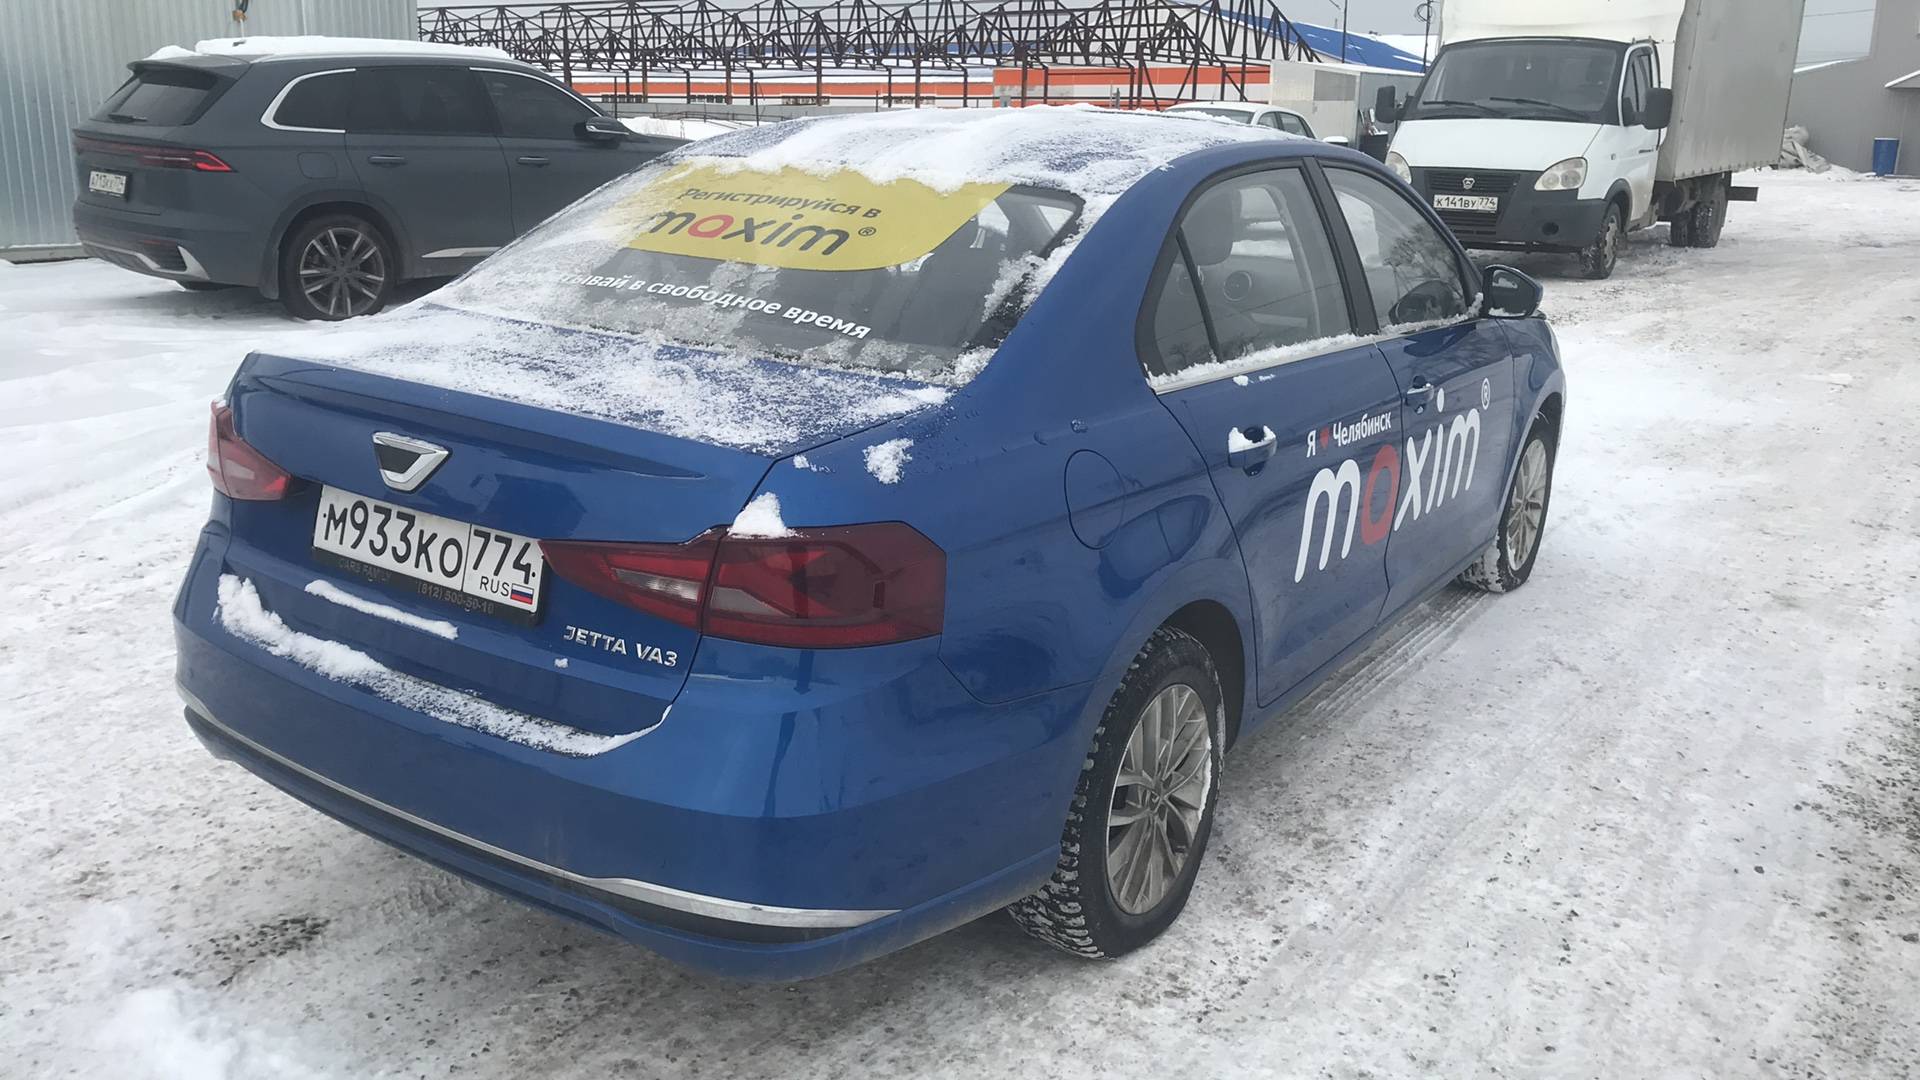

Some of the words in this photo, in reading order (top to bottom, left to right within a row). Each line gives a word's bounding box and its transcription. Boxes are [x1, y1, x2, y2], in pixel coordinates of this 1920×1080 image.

[677, 187, 861, 216] Регистрируйся
[862, 207, 881, 219] в
[1436, 196, 1476, 208] К141ВУ
[628, 279, 647, 291] в
[647, 281, 782, 315] свободное
[783, 306, 872, 340] время
[1306, 429, 1317, 458] Я
[1332, 411, 1392, 447] Челябинск
[323, 500, 463, 578] М933КО
[473, 529, 533, 585] 774
[480, 575, 510, 597] RUS
[563, 625, 627, 655] JETTA
[636, 642, 678, 667] VA3
